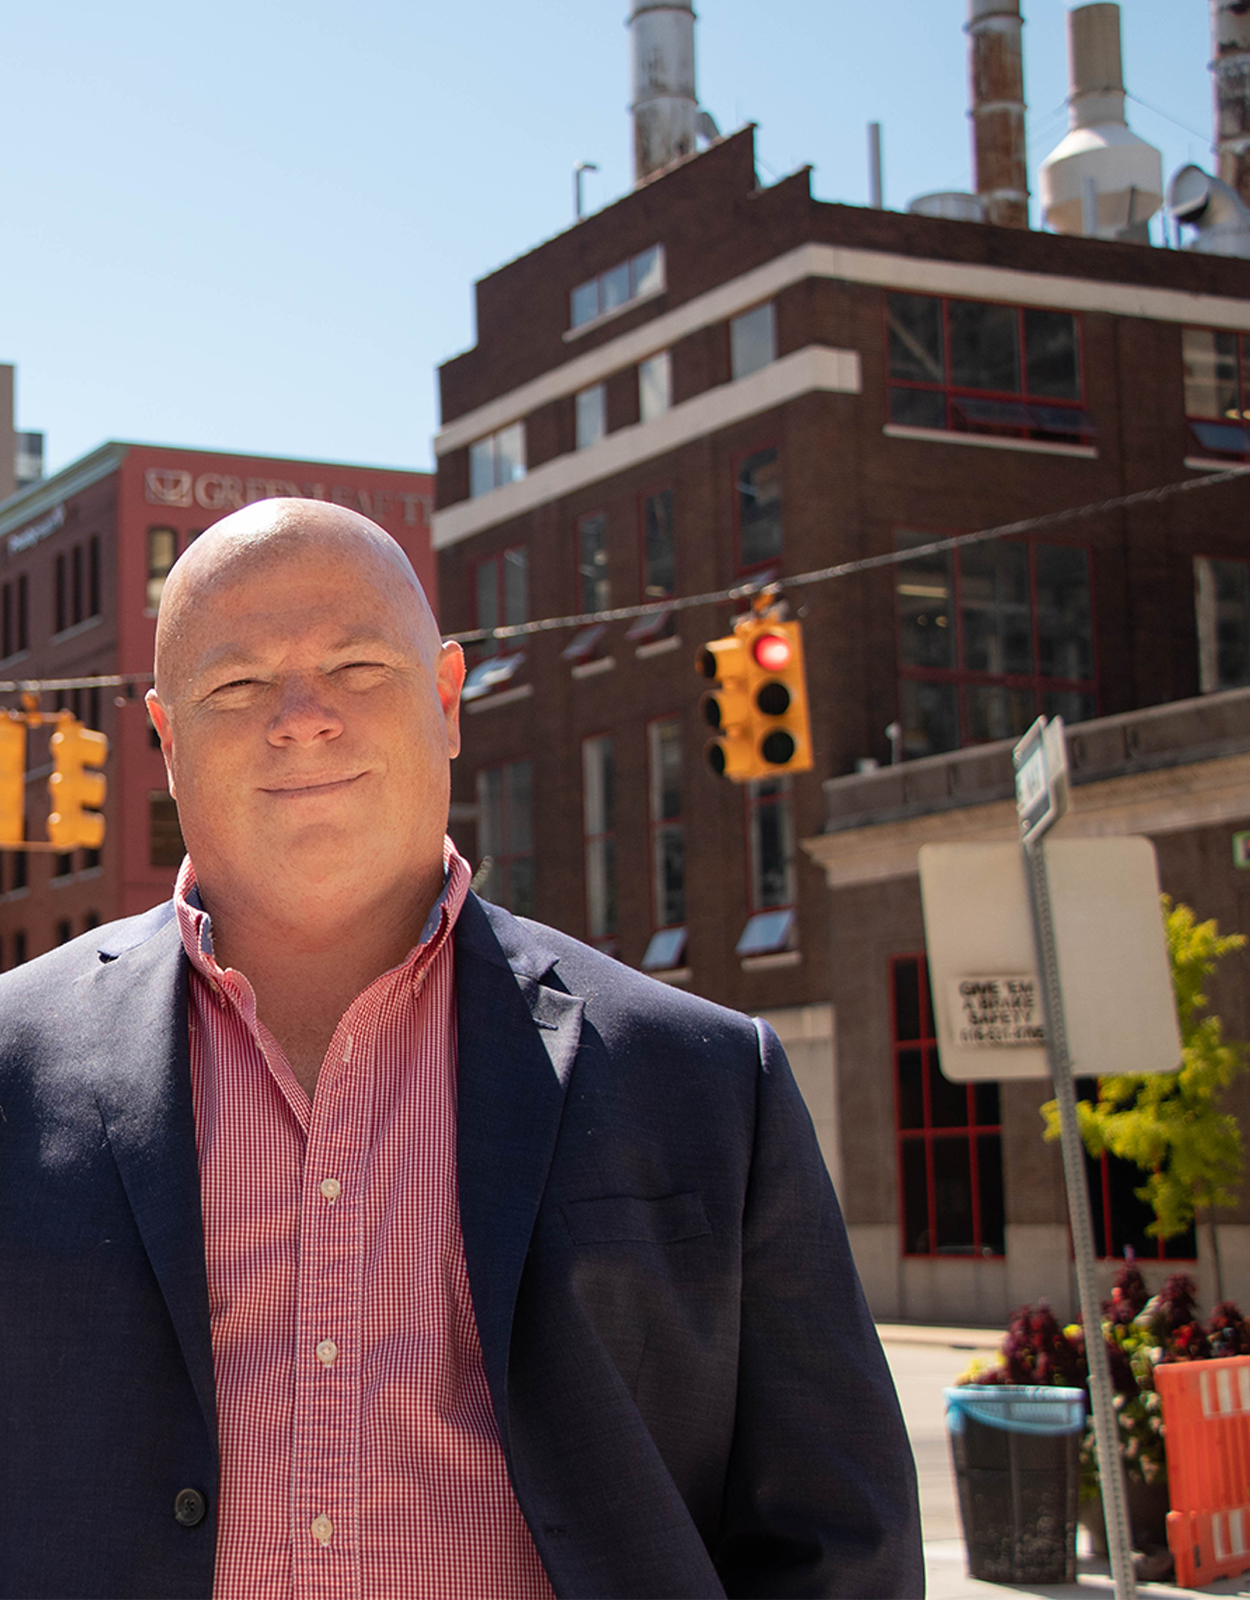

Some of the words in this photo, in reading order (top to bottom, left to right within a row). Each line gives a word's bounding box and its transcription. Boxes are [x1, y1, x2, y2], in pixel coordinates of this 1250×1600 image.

[959, 981, 998, 996] GIVE
[978, 995, 1034, 1009] BRAKE
[969, 1010, 1032, 1024] SAFETY
